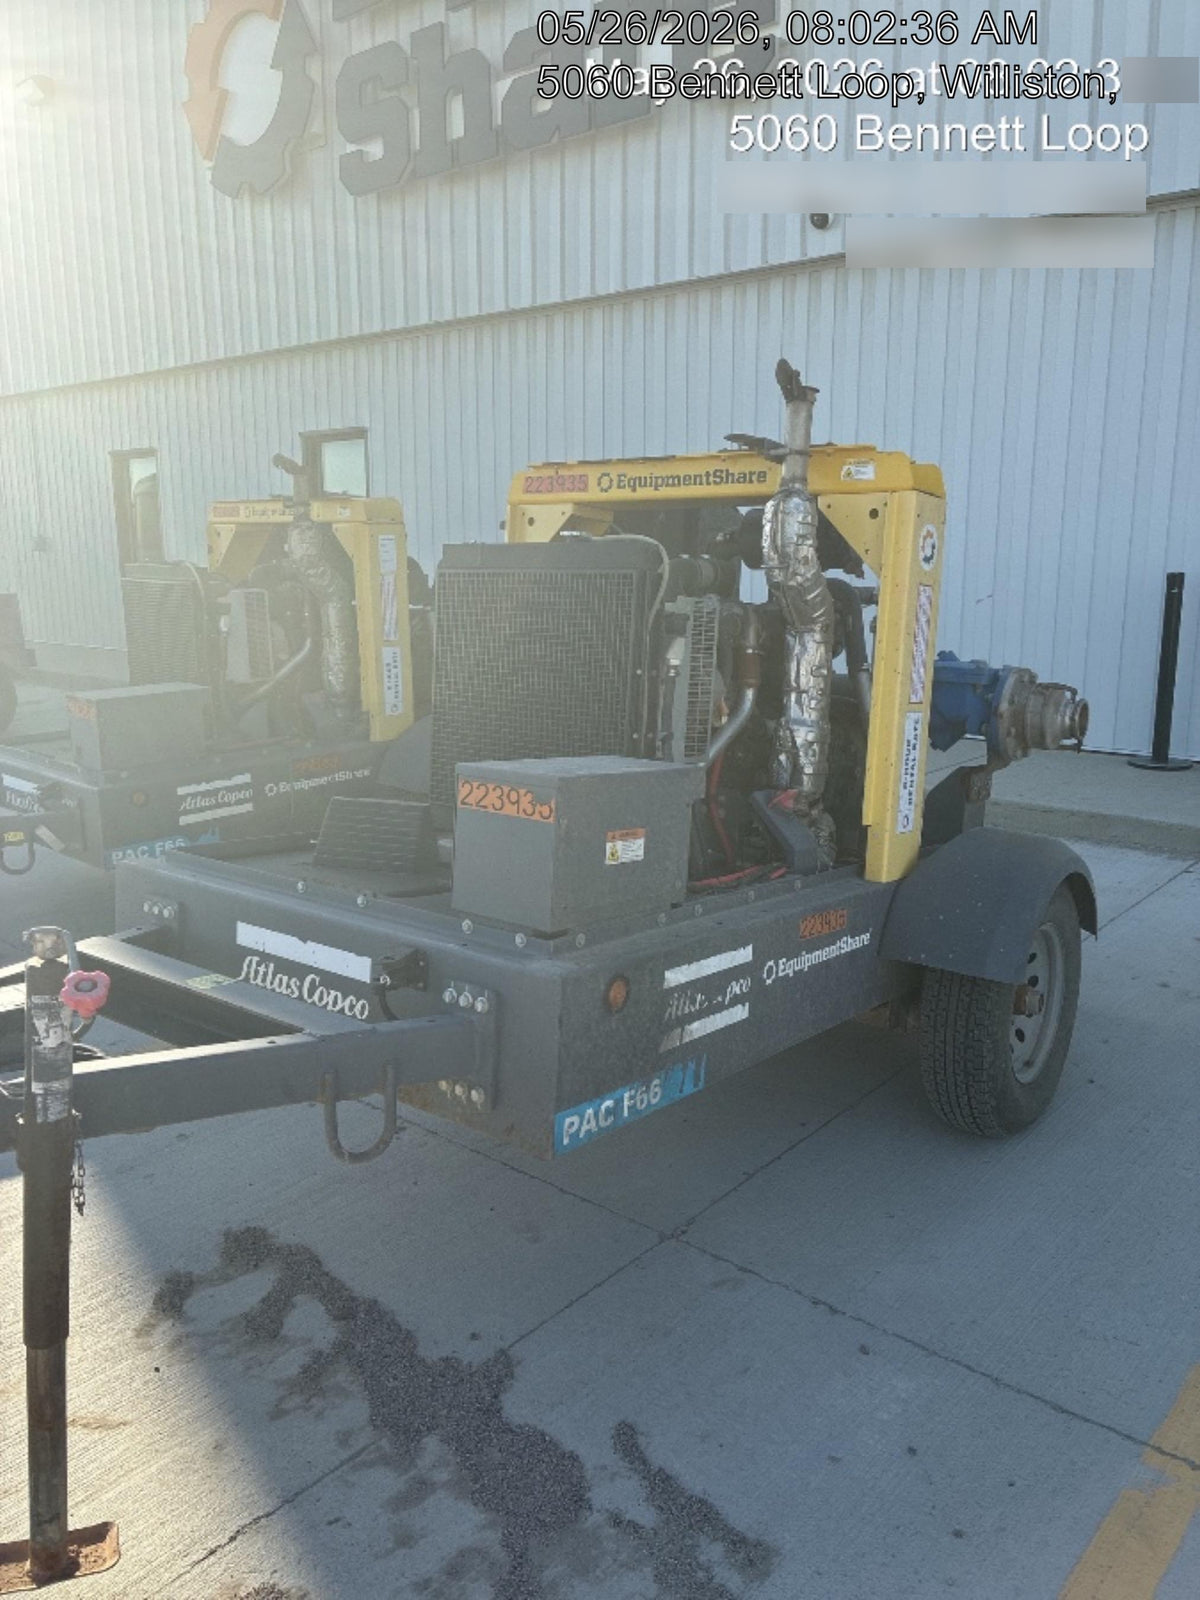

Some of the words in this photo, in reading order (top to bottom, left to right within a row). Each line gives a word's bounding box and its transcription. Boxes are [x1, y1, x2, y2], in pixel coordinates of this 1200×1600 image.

[615, 469, 768, 493] EquipmentShare
[112, 846, 150, 865] PAC
[778, 931, 872, 977] EquipmentShare
[238, 955, 301, 999] Atlas
[301, 973, 370, 1021] Copco
[562, 1099, 616, 1147] PAC
[622, 1078, 663, 1118] F66
